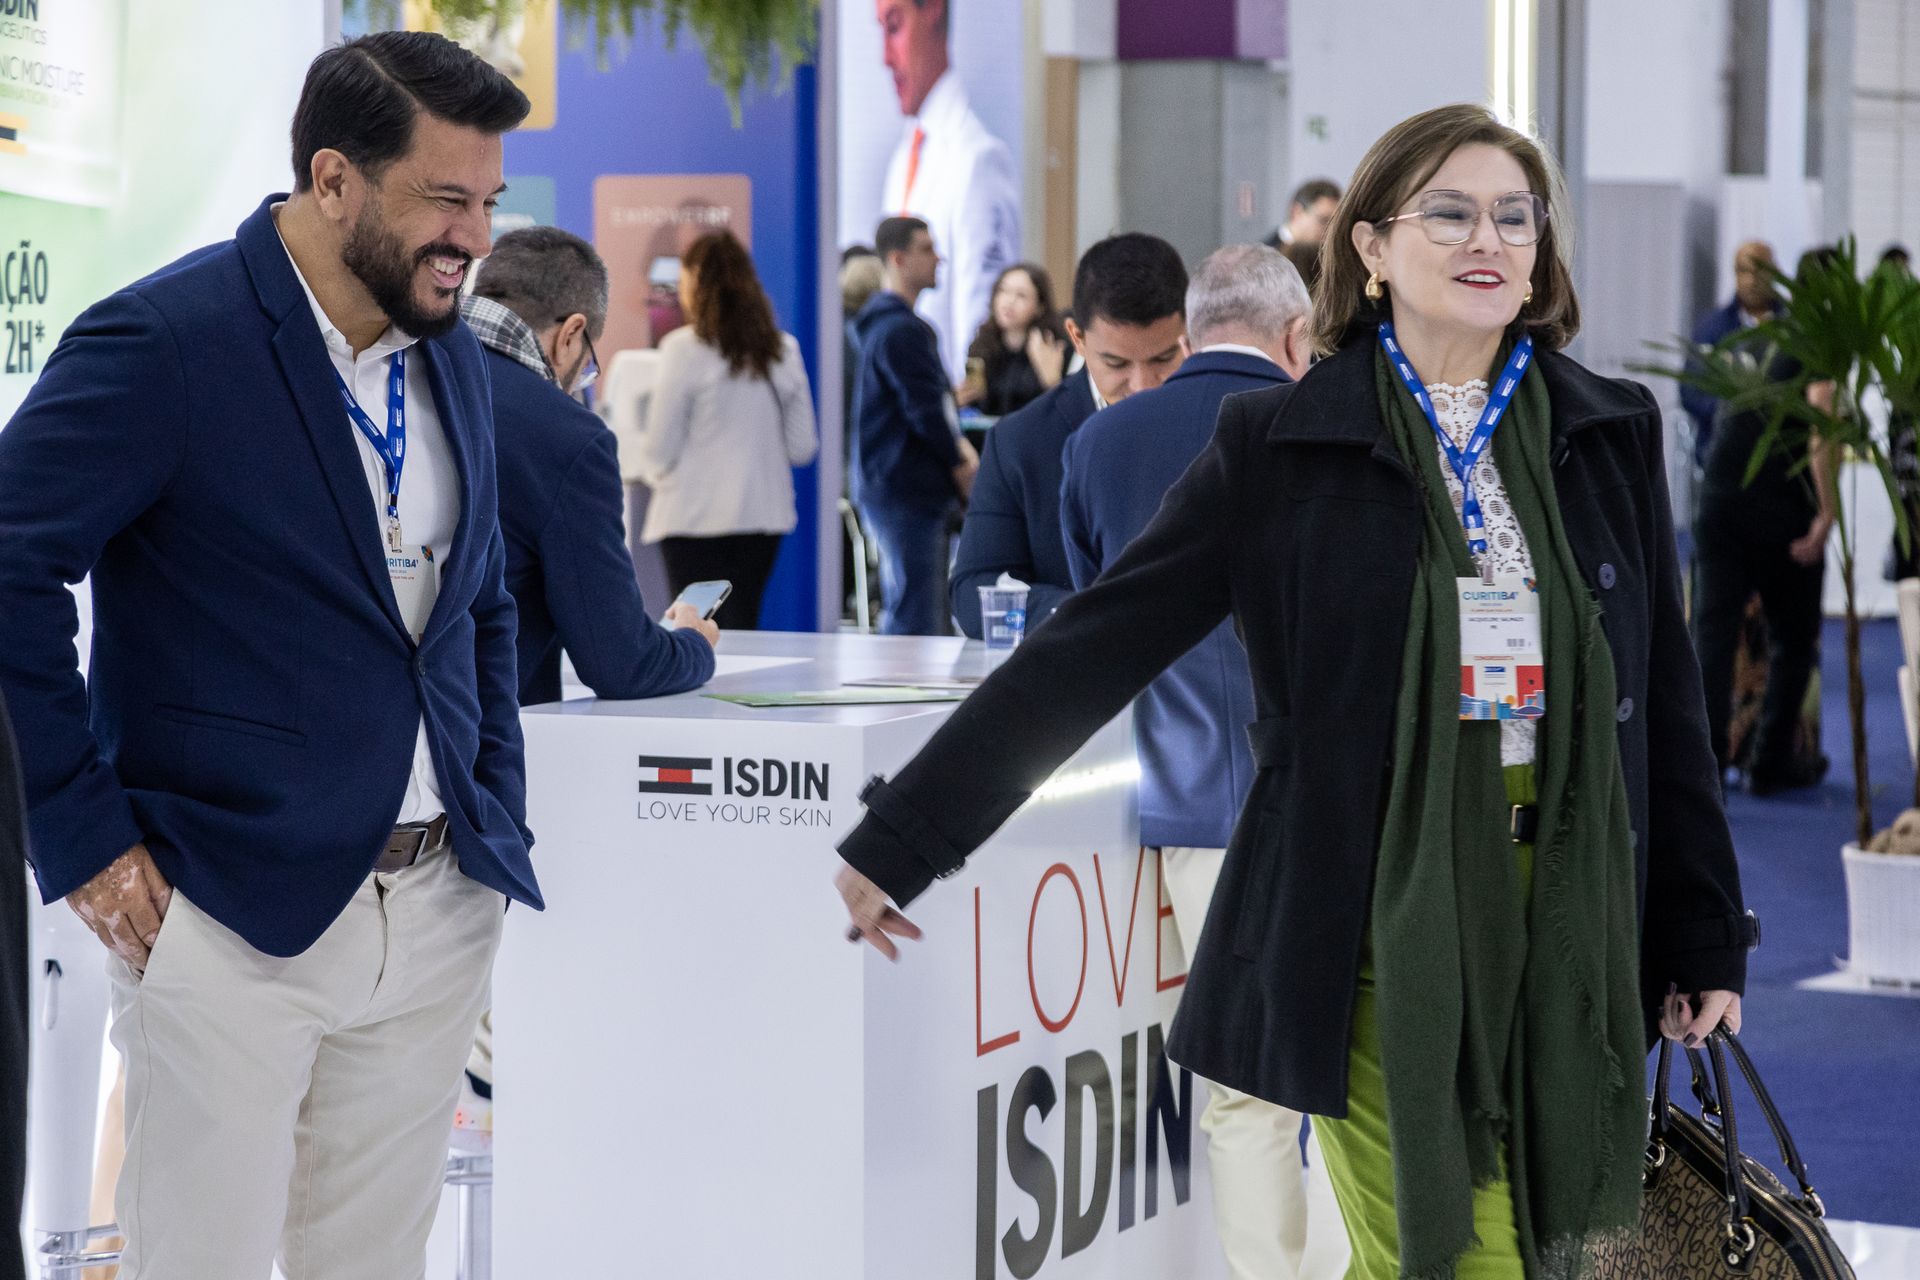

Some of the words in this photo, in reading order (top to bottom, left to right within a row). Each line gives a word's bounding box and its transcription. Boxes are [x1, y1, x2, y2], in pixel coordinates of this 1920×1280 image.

[0, 239, 49, 312] ÇÃO
[637, 801, 697, 821] LOVE
[706, 803, 771, 824] YOUR
[779, 807, 832, 827] SKIN
[724, 757, 829, 801] ISDIN
[974, 847, 1188, 1057] LOVE
[975, 1022, 1193, 1280] ISDIN
